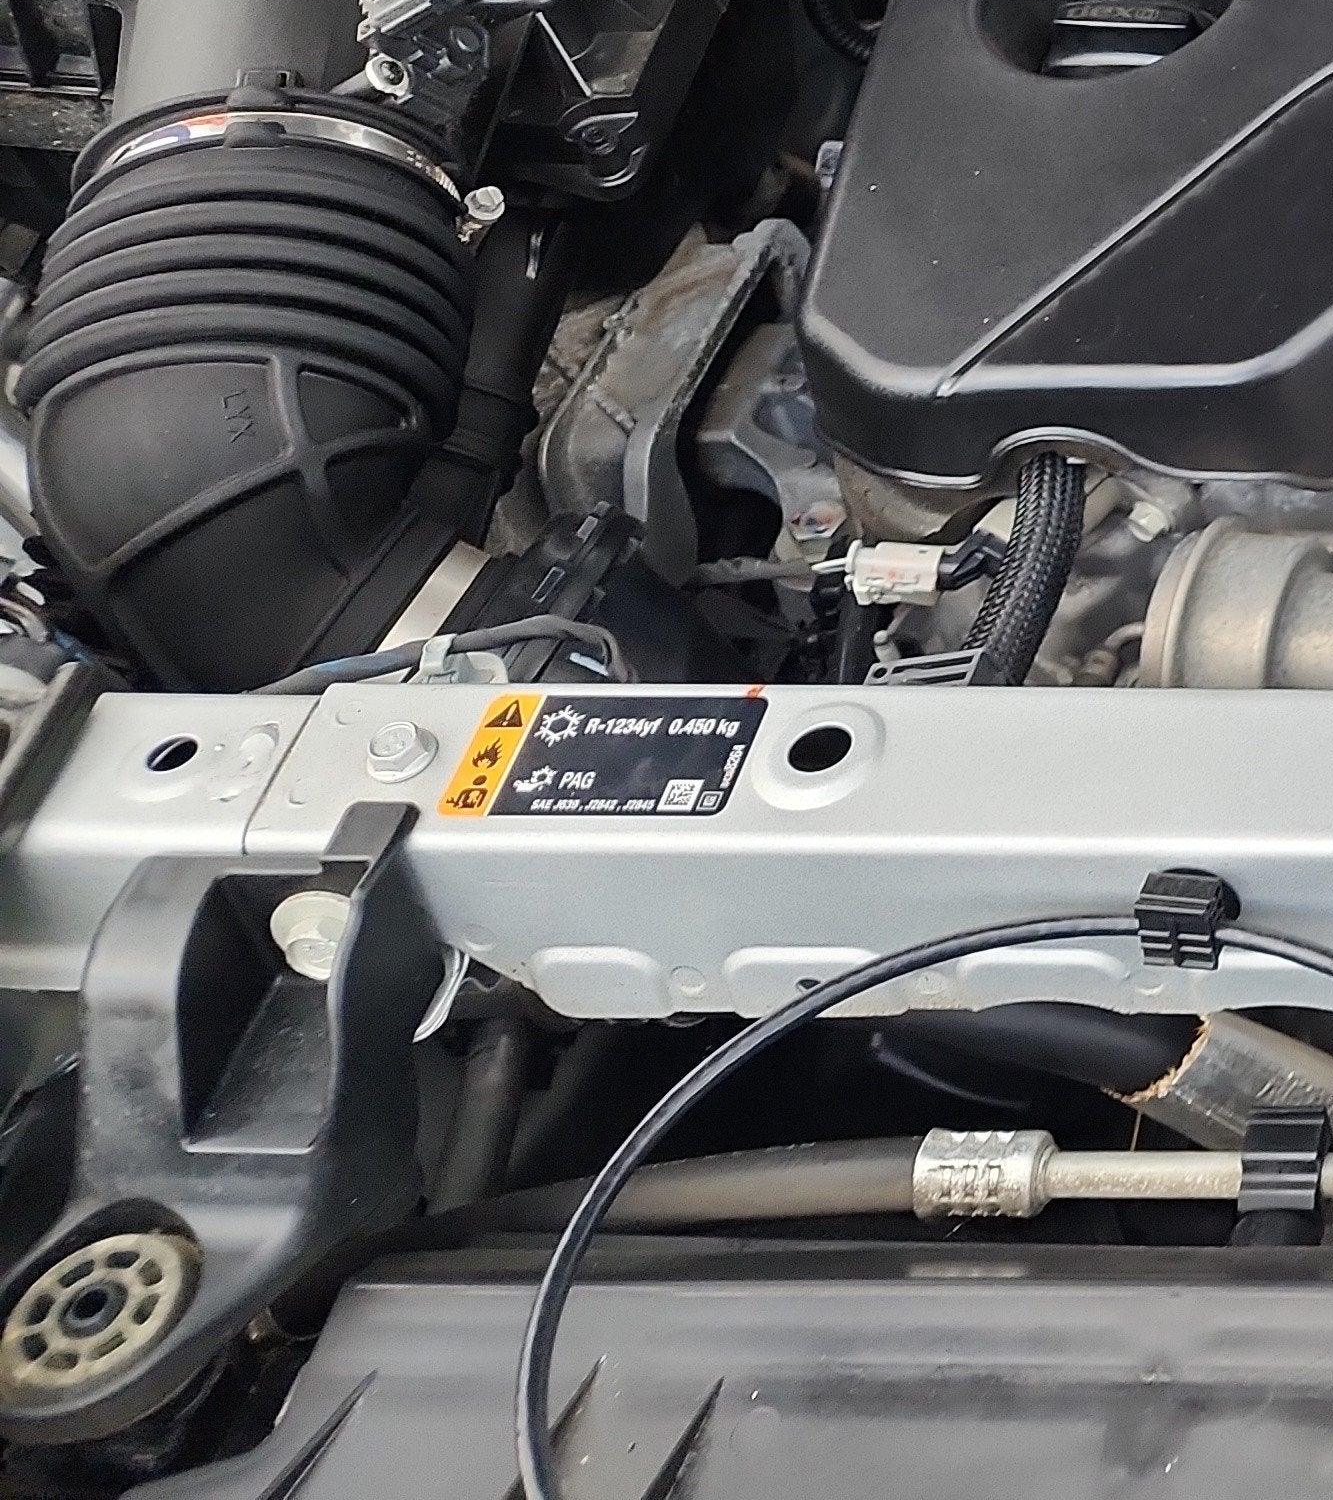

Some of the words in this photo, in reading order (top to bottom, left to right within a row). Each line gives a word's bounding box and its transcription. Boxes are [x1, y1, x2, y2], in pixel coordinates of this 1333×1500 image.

[584, 717, 662, 738] R-1234yf
[668, 717, 714, 736] 0.450
[716, 719, 741, 739] kg
[558, 771, 597, 790] PAG
